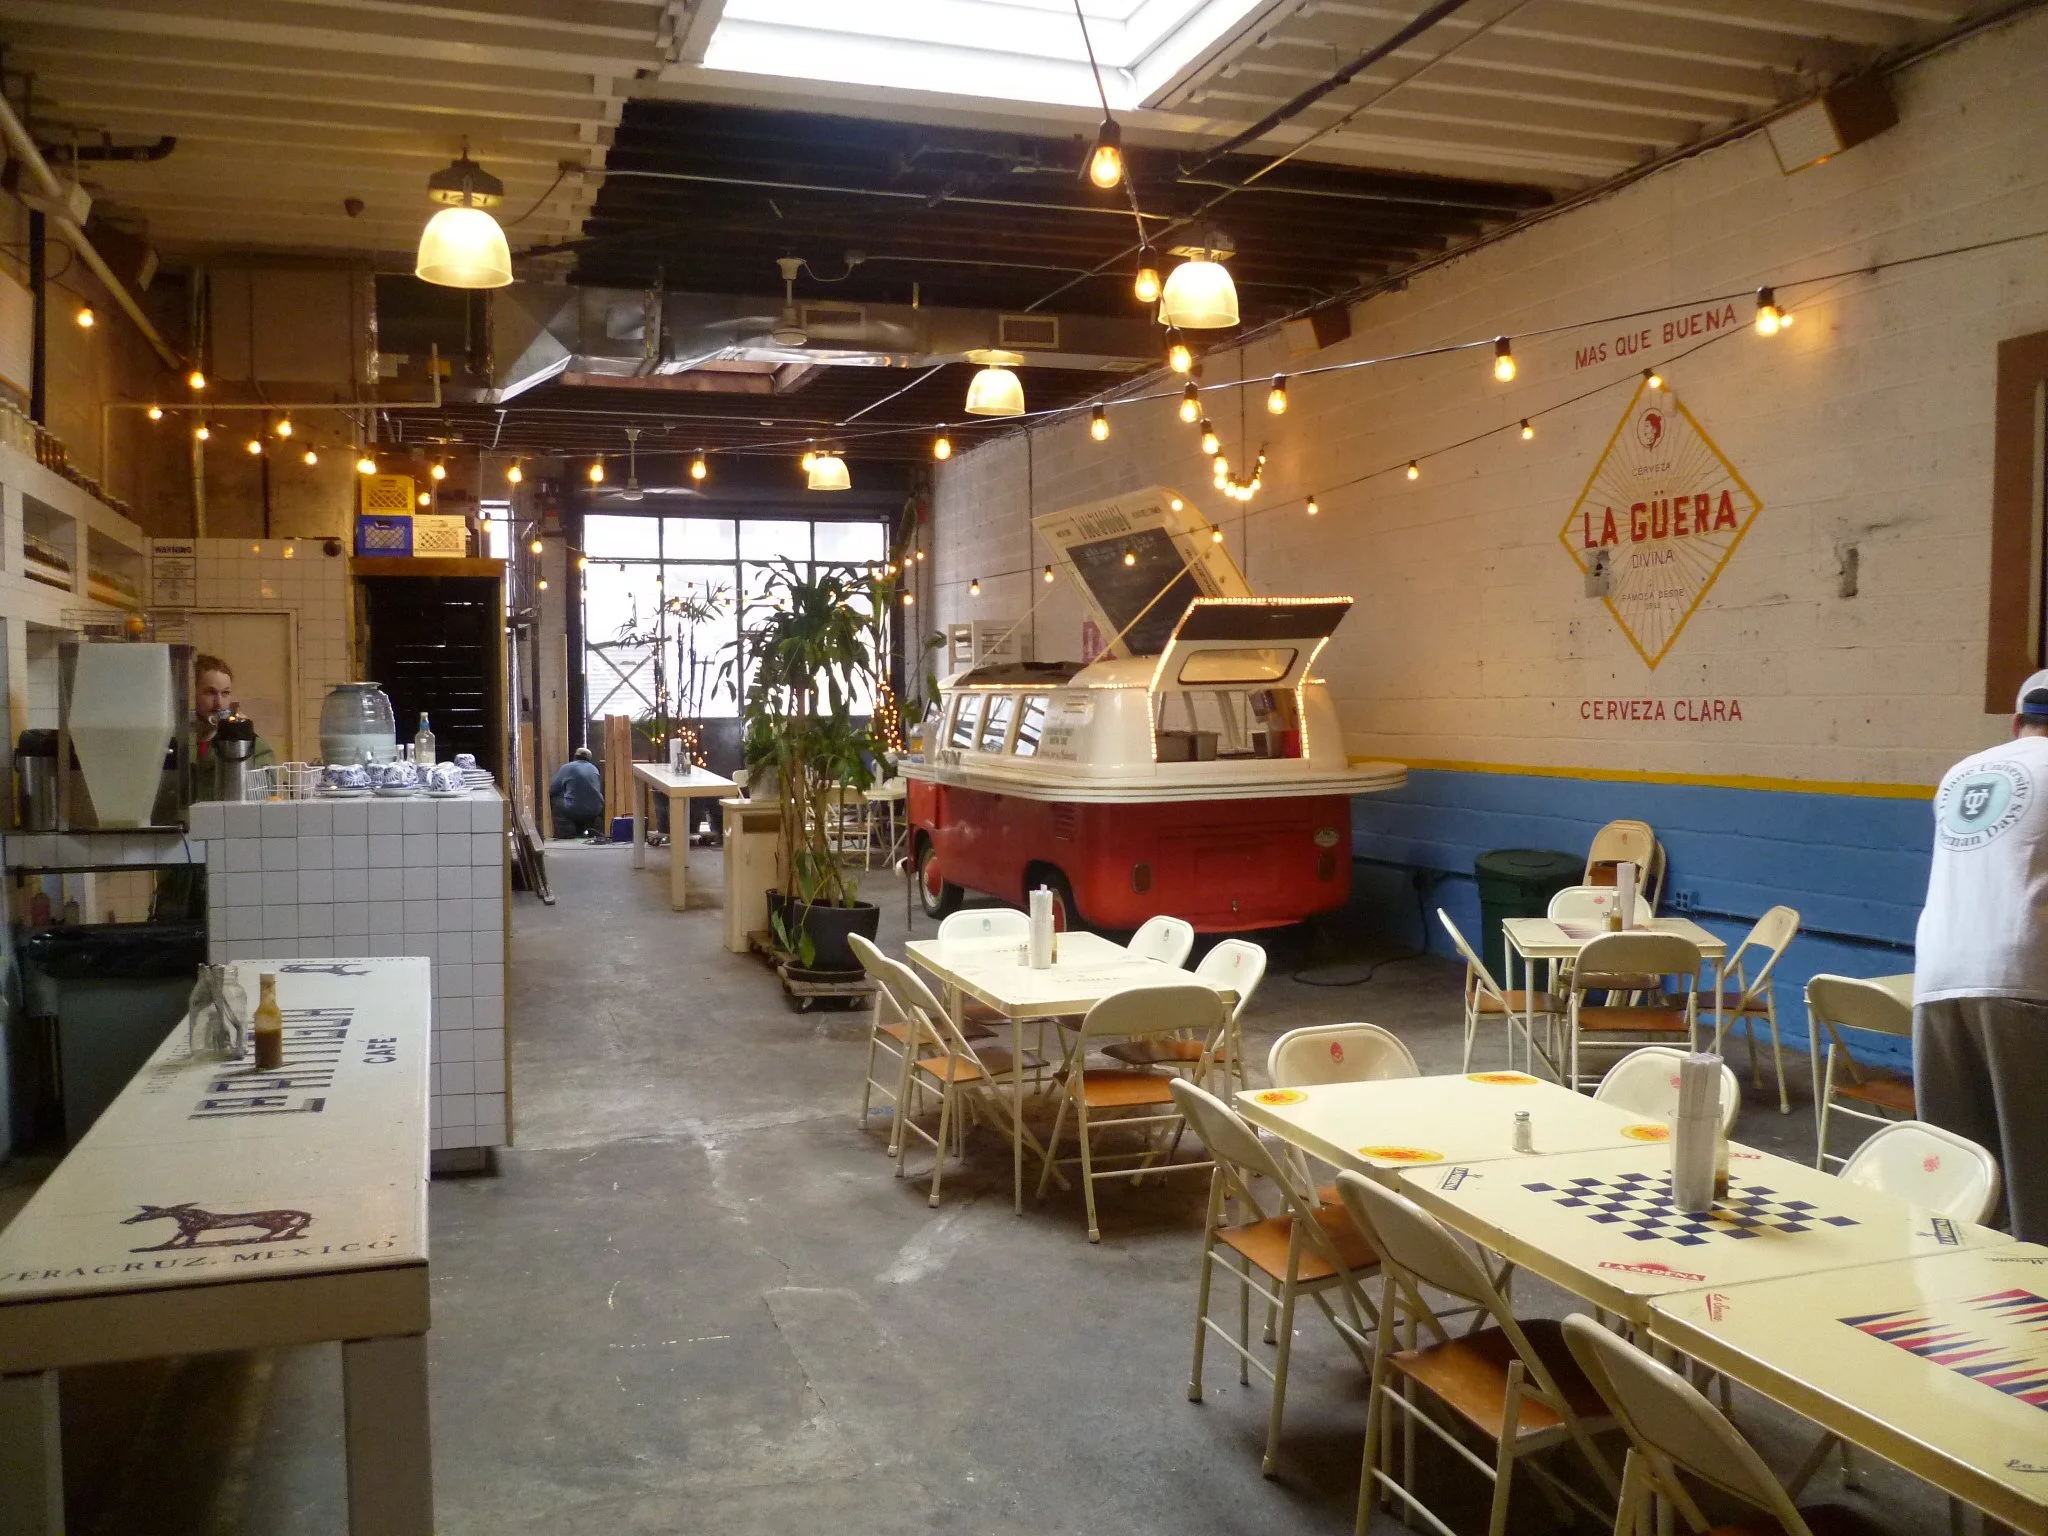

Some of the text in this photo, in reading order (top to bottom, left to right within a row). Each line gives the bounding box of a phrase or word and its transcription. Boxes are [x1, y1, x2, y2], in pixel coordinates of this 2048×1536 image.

[1575, 304, 1737, 370] MAS QUE BUENA
[1584, 489, 1738, 548] LA GÜERA
[1632, 549, 1674, 568] DIVINA
[1580, 699, 1743, 722] CERVEZA CLARA
